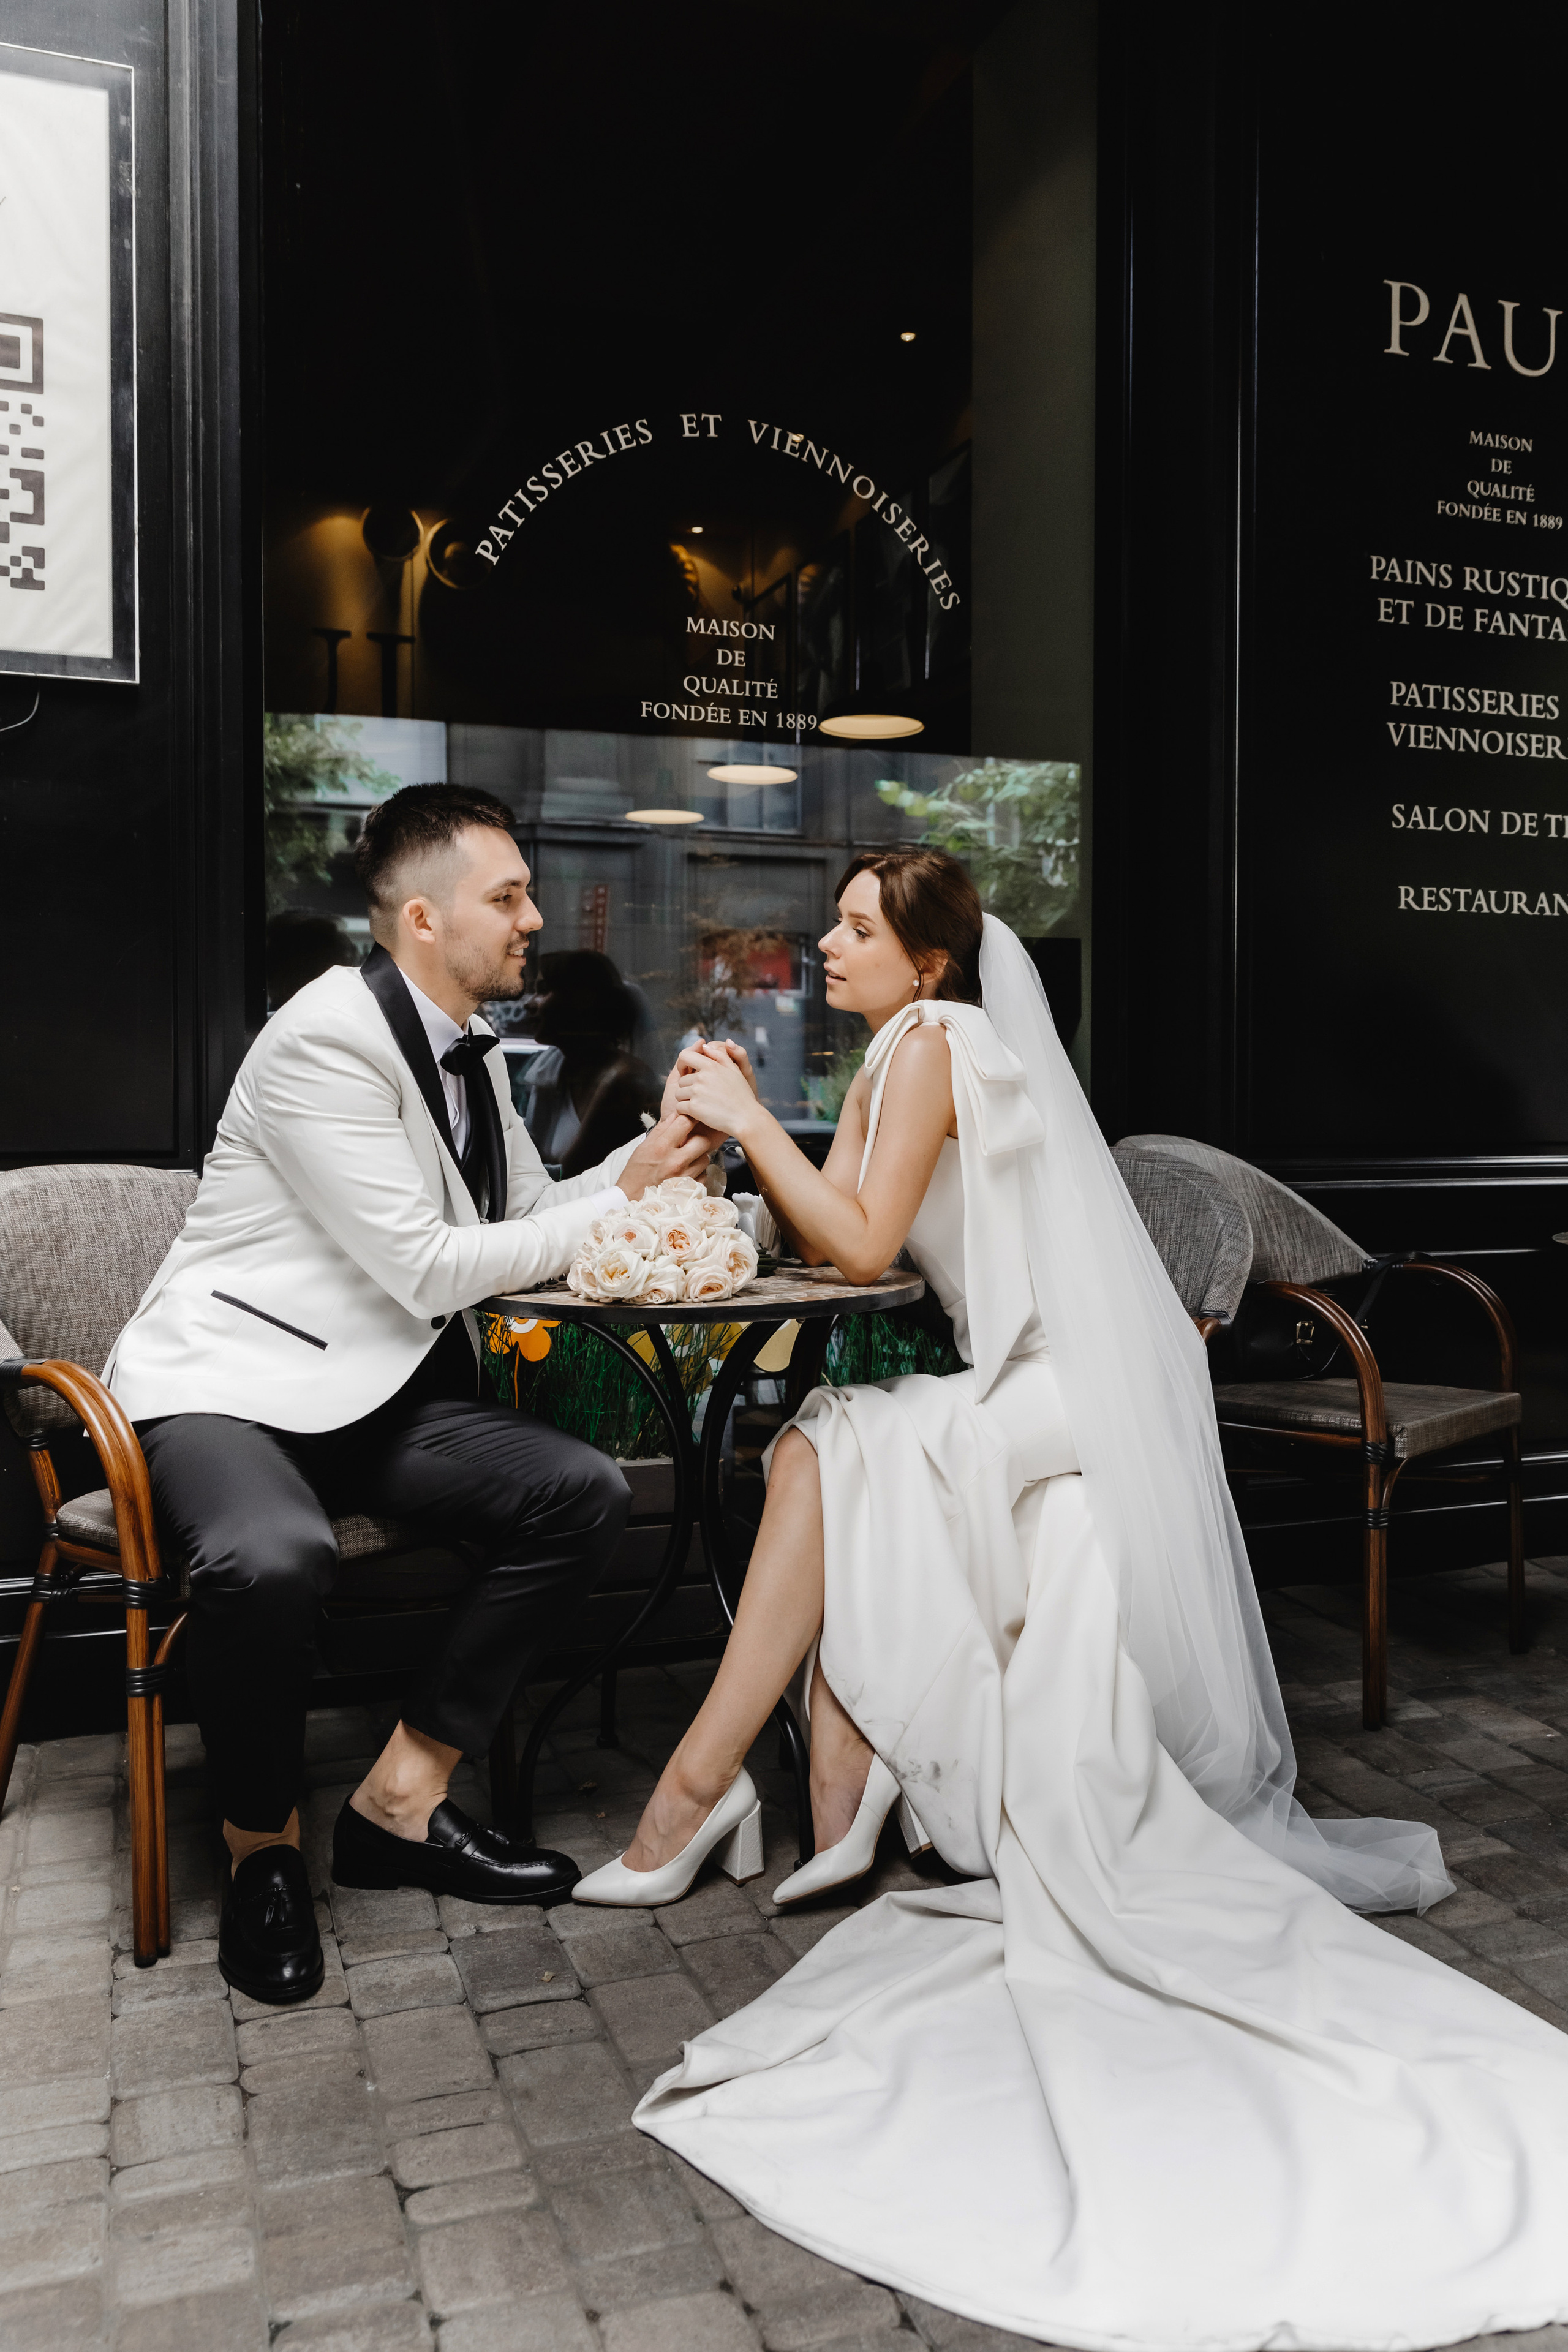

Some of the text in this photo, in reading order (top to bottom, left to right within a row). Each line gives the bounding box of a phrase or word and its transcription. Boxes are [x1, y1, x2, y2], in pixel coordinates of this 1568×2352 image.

[1383, 279, 1564, 377] PAU
[1469, 430, 1533, 453] MAISON
[1491, 458, 1512, 475] DE
[1467, 480, 1536, 502] QUALITÉ
[475, 413, 960, 610] PATISSERIES ET VIENNOISERIES
[1437, 500, 1563, 530] FONDÉE EN 1889
[1370, 555, 1568, 611] PAINS RUSTIQ
[685, 617, 775, 641] MAISON
[1378, 597, 1568, 642] ET DE FANTA
[716, 649, 746, 667] DE
[683, 676, 778, 699] QUALITÉ
[1390, 681, 1559, 720] PATISSERIES
[641, 701, 817, 730] FONDÉE EN 1889
[1387, 722, 1568, 760] VIENNOISER
[1392, 804, 1568, 839] SALON DE T
[1398, 886, 1568, 917] RESTAURAN
